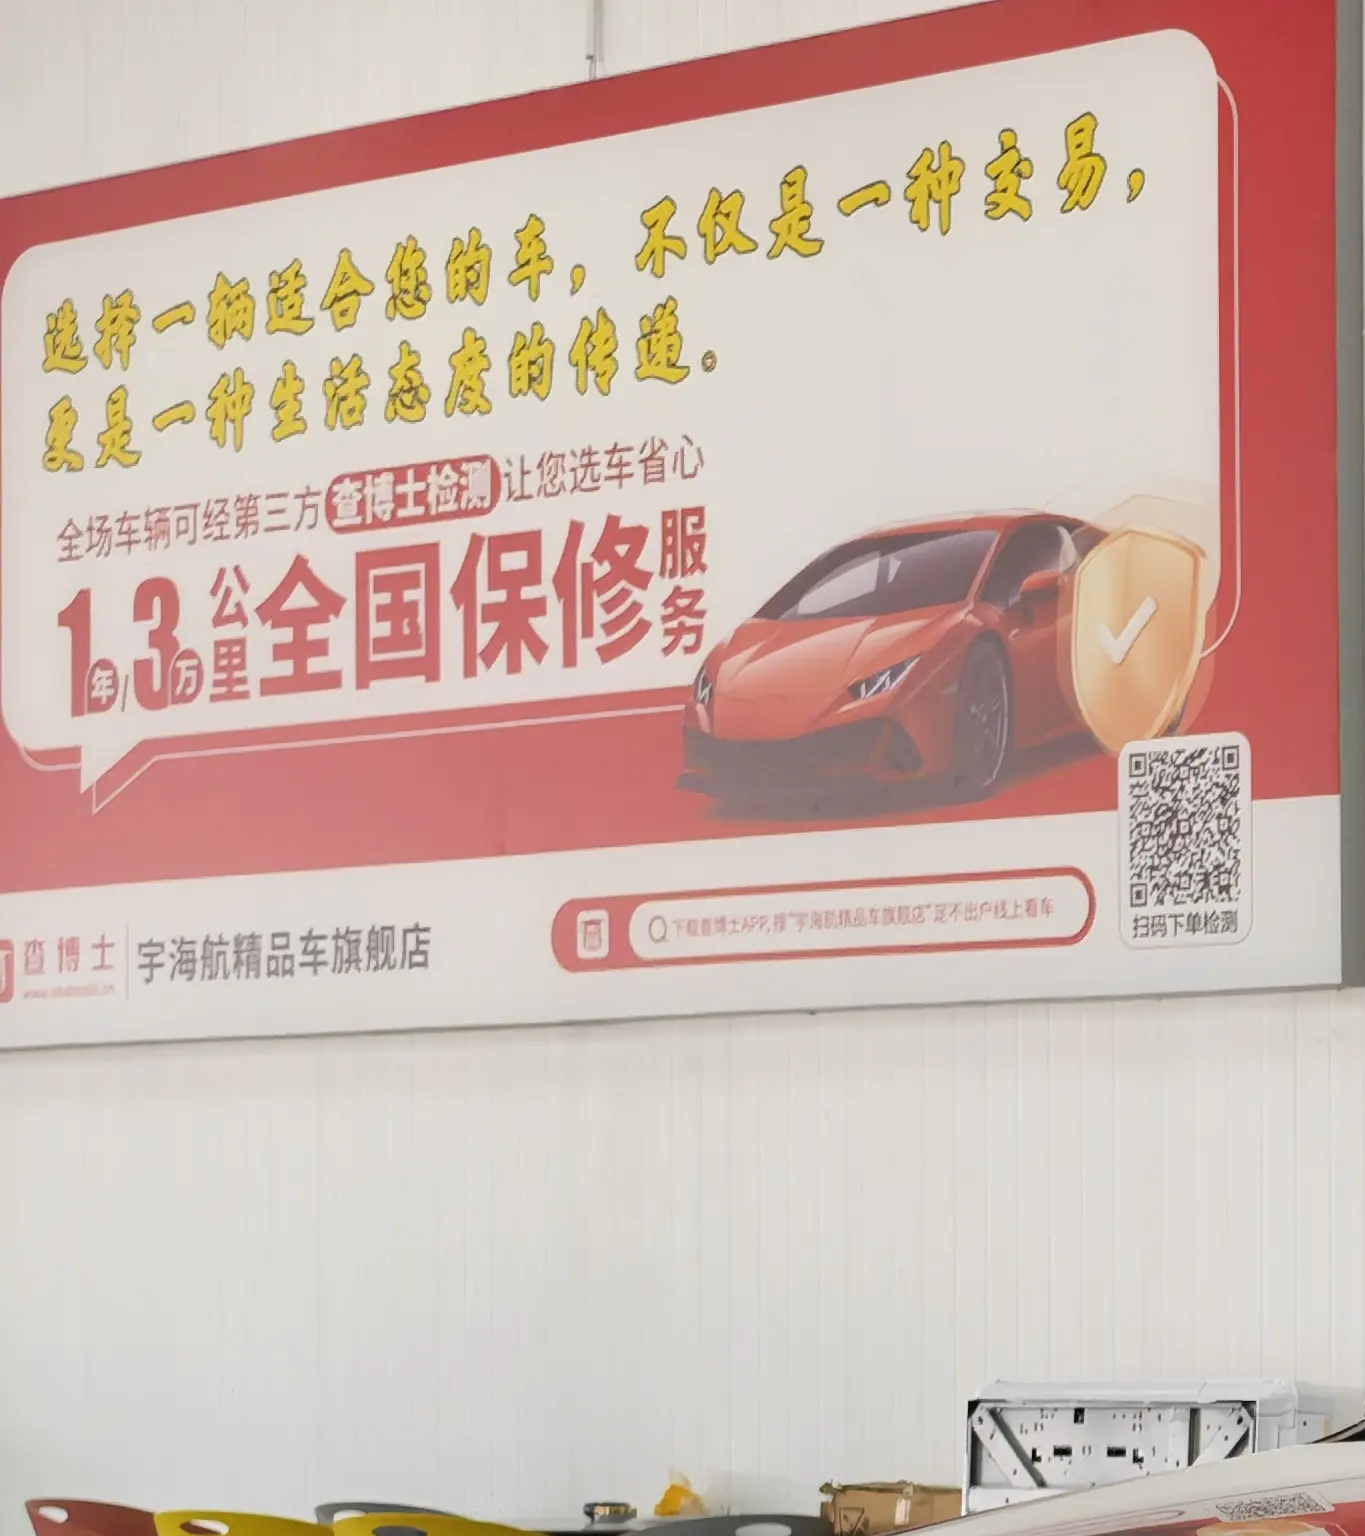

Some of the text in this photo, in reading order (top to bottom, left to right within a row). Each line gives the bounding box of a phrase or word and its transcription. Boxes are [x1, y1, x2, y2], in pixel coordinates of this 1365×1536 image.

[1132, 909, 1239, 940] 扫码下单检测
[136, 921, 432, 985] 宇海航精品车旗舰店
